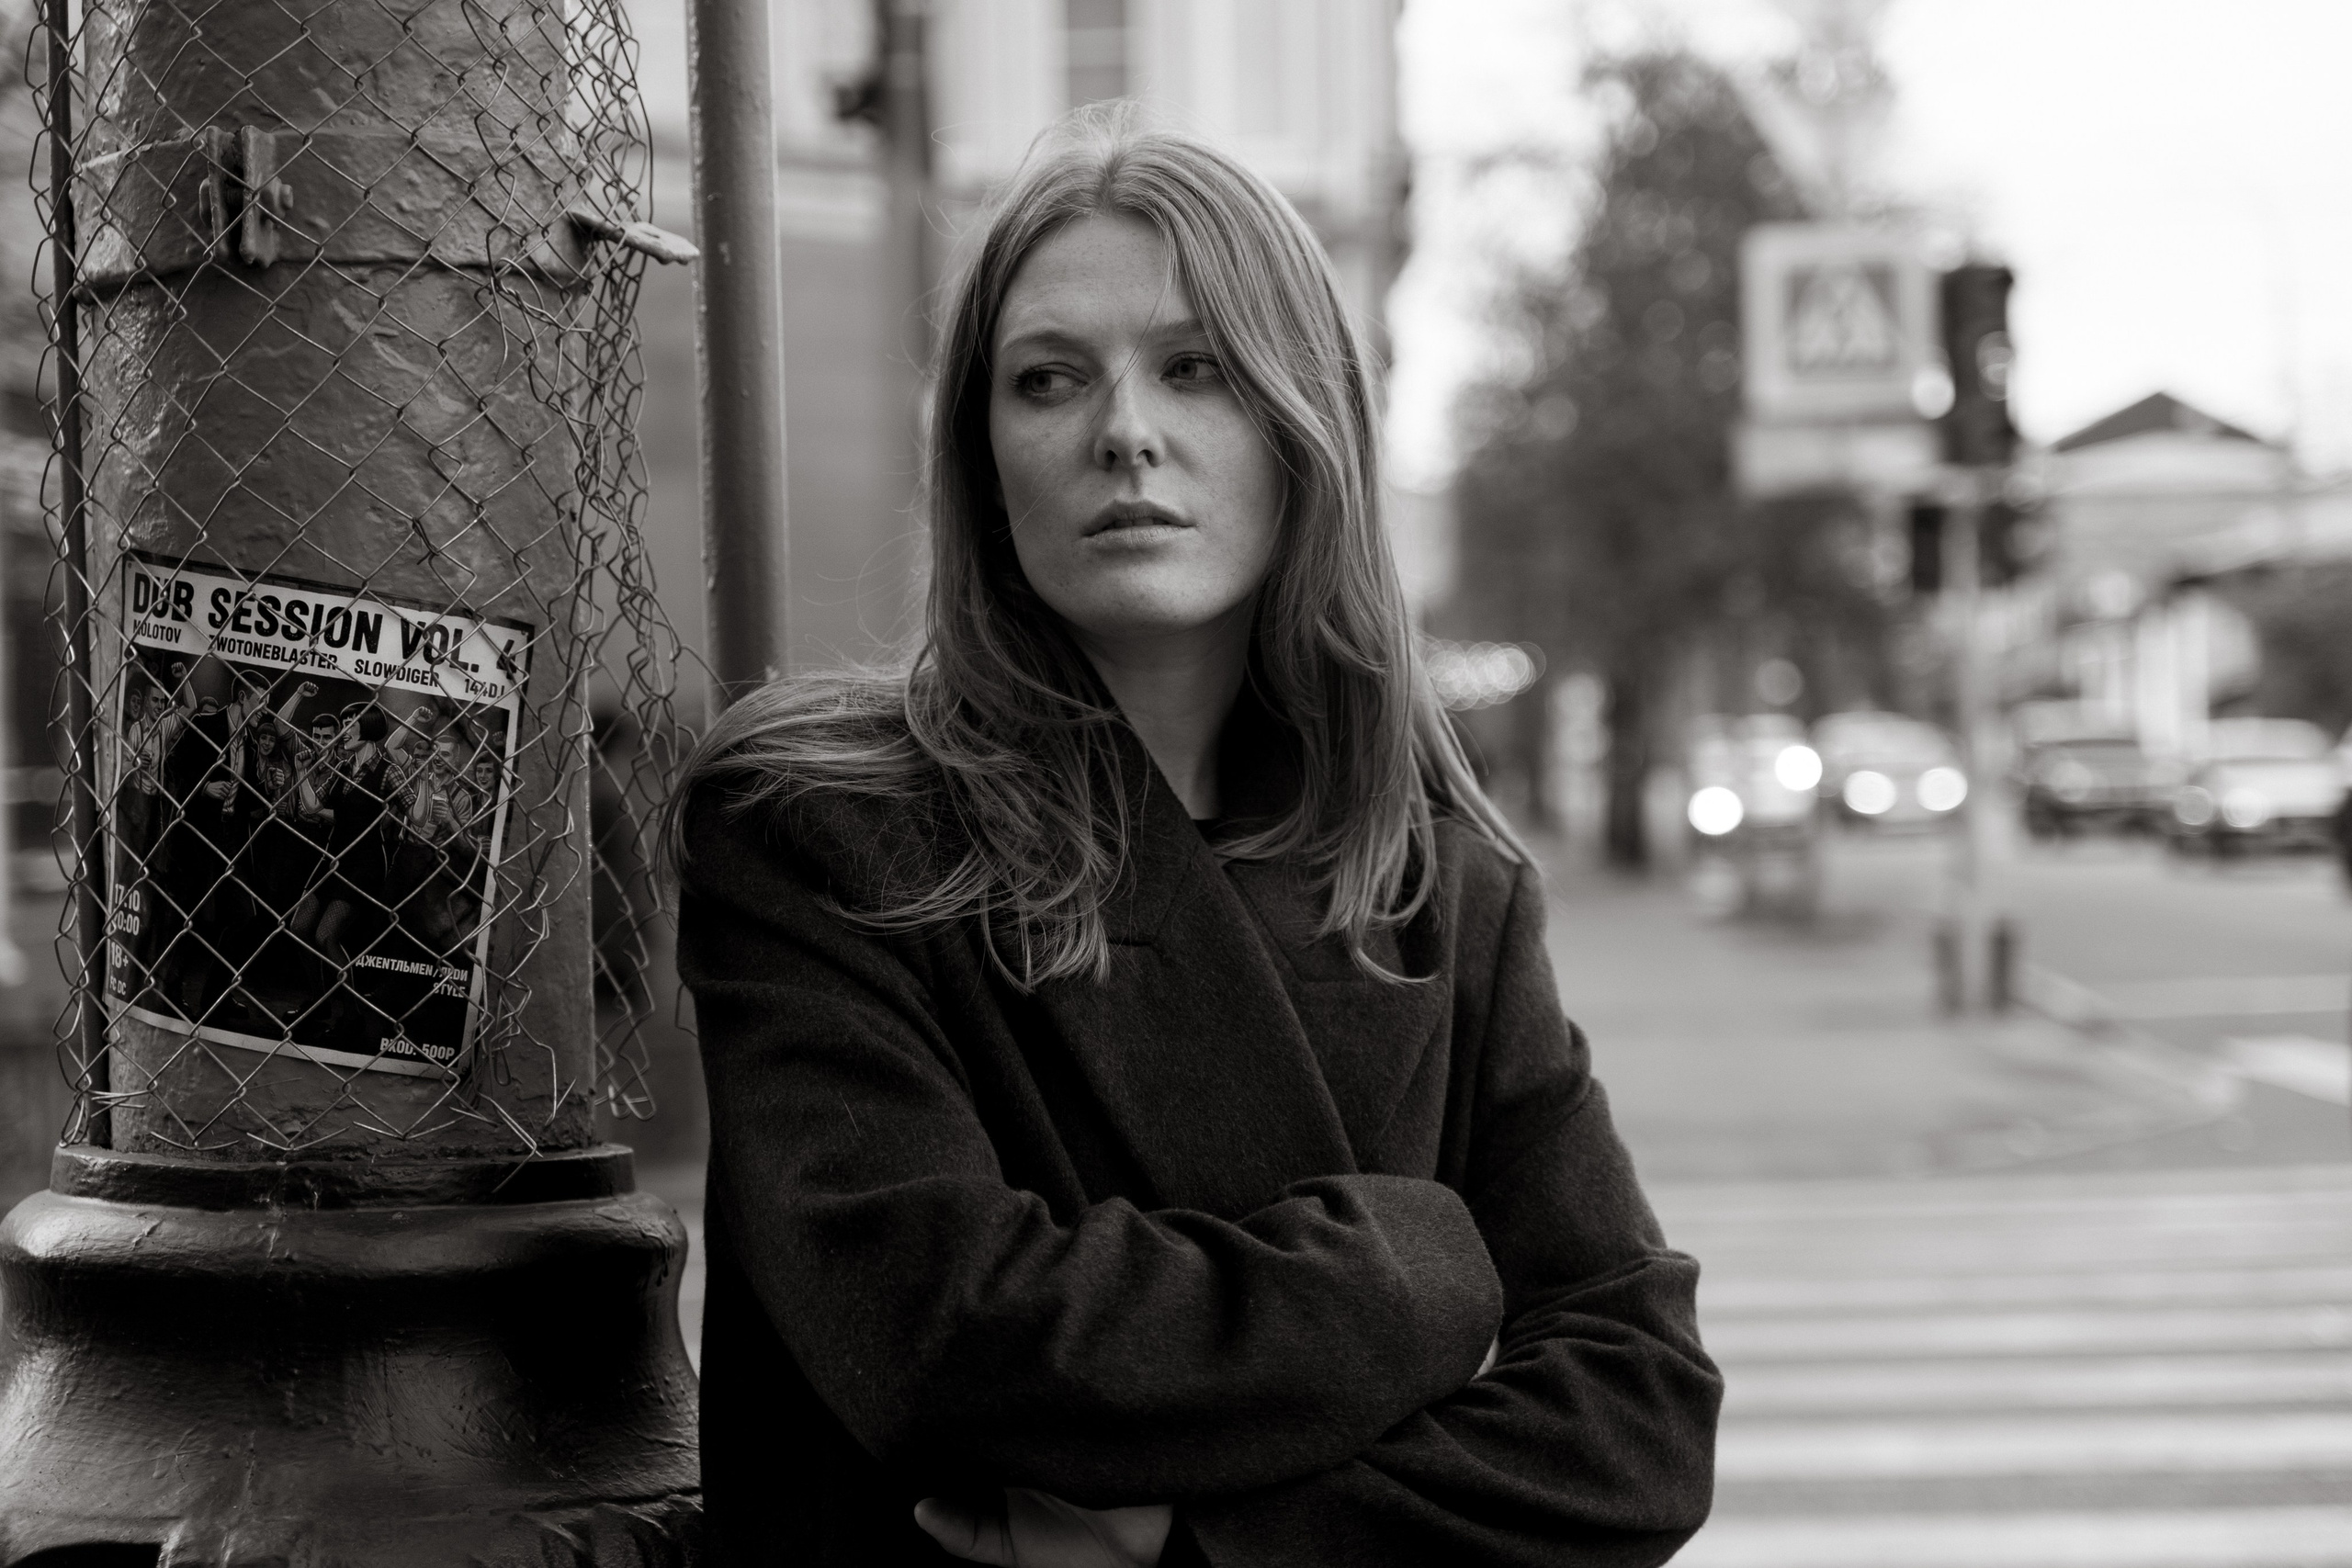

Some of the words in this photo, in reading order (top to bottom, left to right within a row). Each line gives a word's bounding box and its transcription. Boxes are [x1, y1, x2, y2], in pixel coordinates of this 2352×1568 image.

[133, 572, 195, 623] DUB
[208, 586, 383, 655] SESSION
[400, 616, 480, 673] VOL.
[496, 638, 517, 681] 4
[132, 618, 182, 644] MOLOTOV
[353, 658, 441, 688] SLOWDIGER
[115, 883, 141, 912] 17.10
[110, 942, 130, 969] 18+
[433, 981, 466, 998] STYLE
